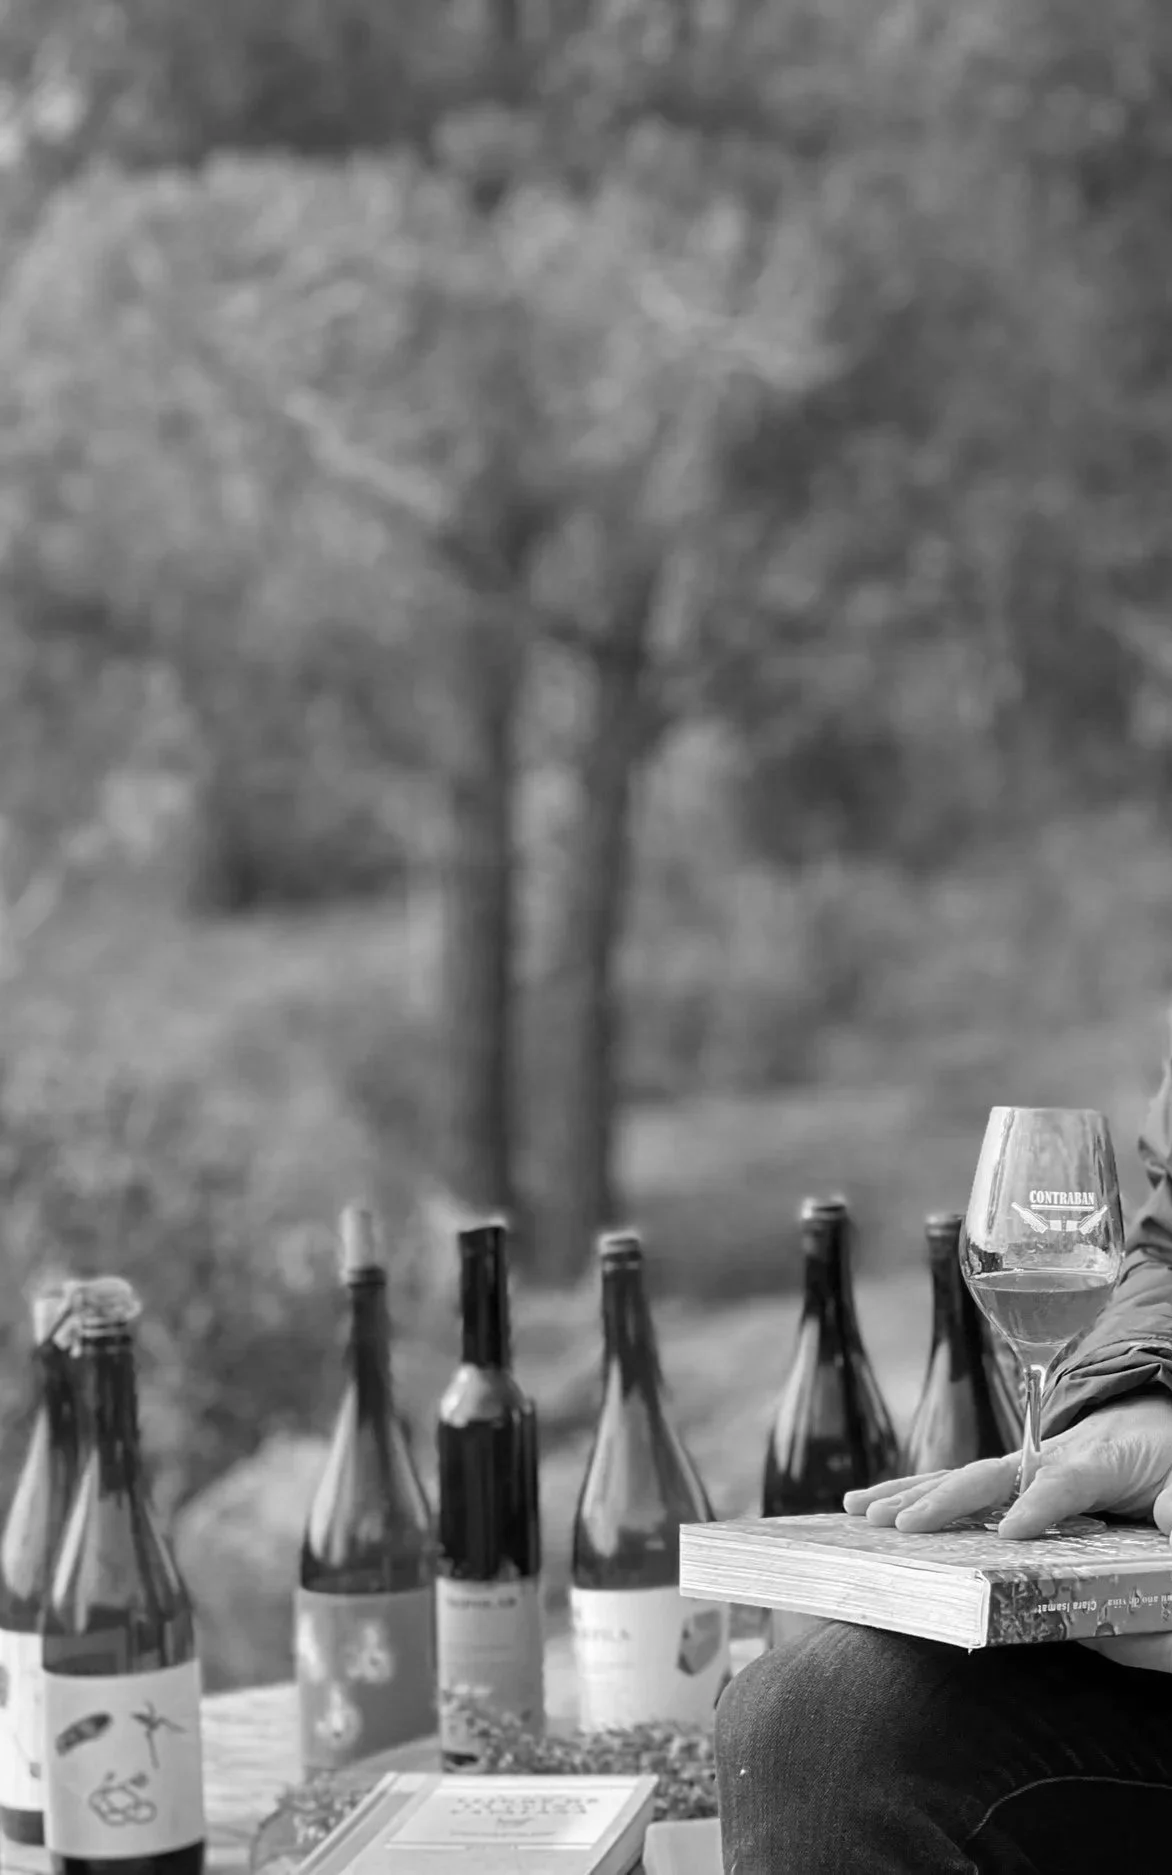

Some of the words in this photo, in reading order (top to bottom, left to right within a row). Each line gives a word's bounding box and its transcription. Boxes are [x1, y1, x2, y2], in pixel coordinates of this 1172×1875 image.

[1029, 1189, 1096, 1206] CONTRABAN
[1037, 1602, 1070, 1615] Isamat
[1072, 1600, 1097, 1612] Clara
